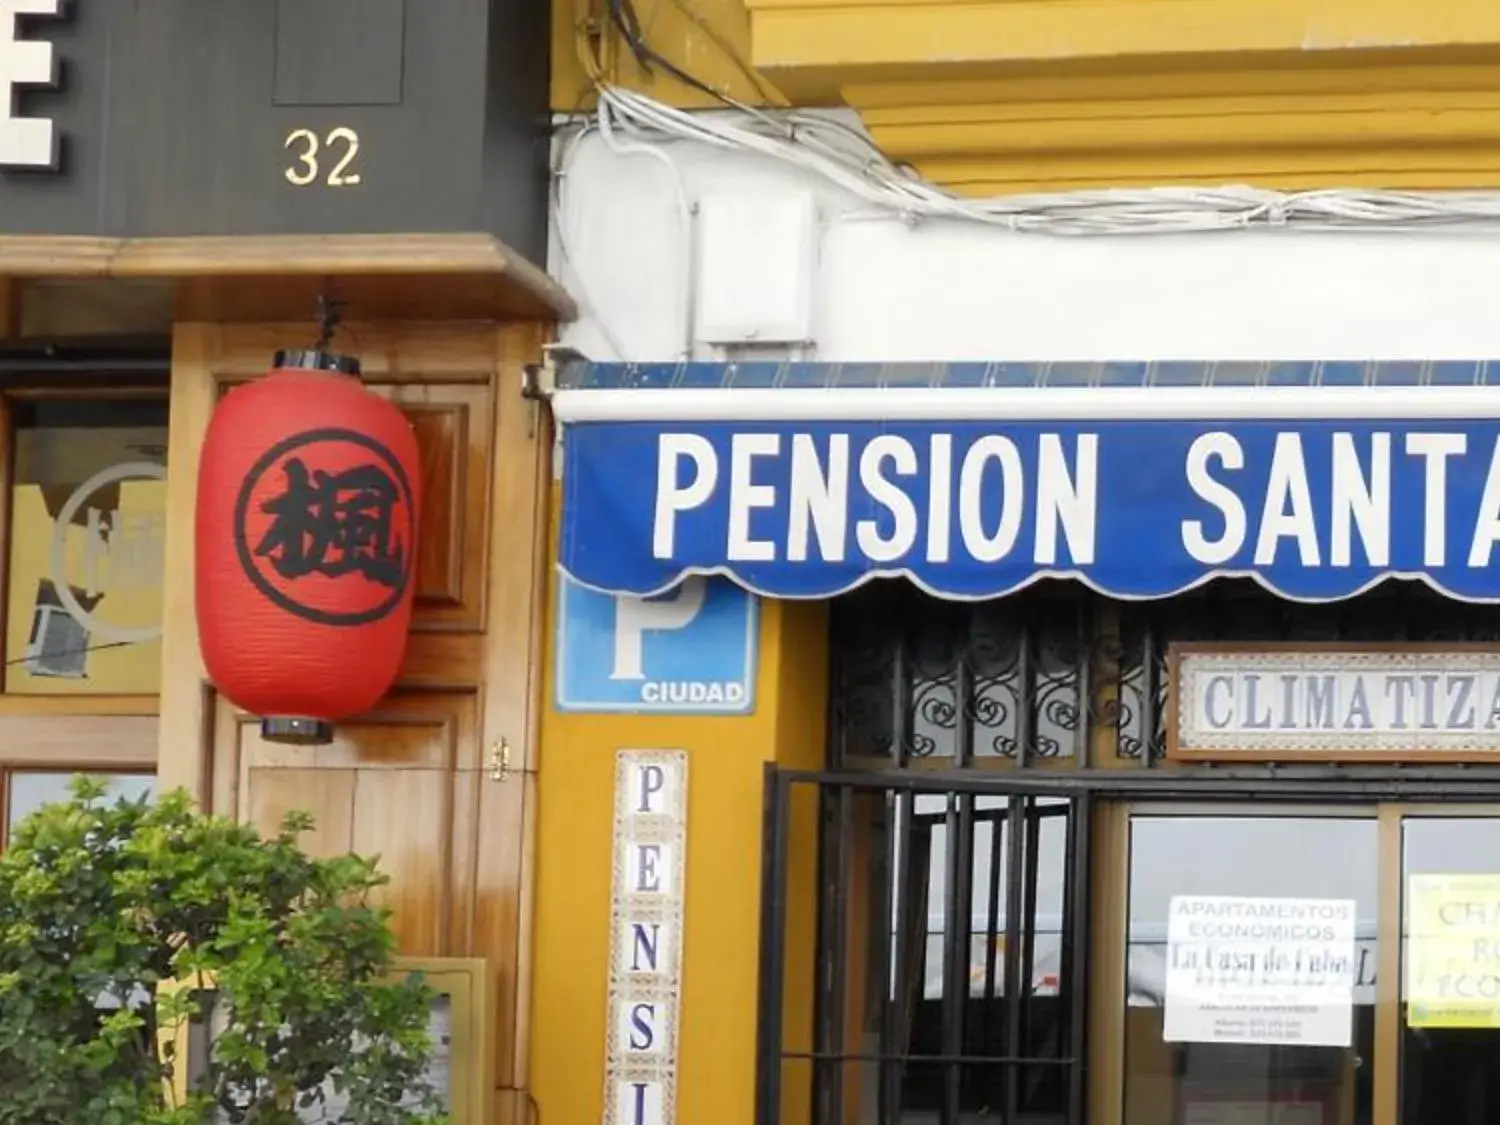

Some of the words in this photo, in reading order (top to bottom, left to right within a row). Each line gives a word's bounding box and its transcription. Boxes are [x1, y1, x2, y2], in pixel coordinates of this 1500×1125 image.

[284, 127, 361, 186] 32
[653, 433, 1098, 564] PENSION
[641, 681, 743, 703] CIUDAD
[1177, 901, 1349, 920] APARTAMENTOS
